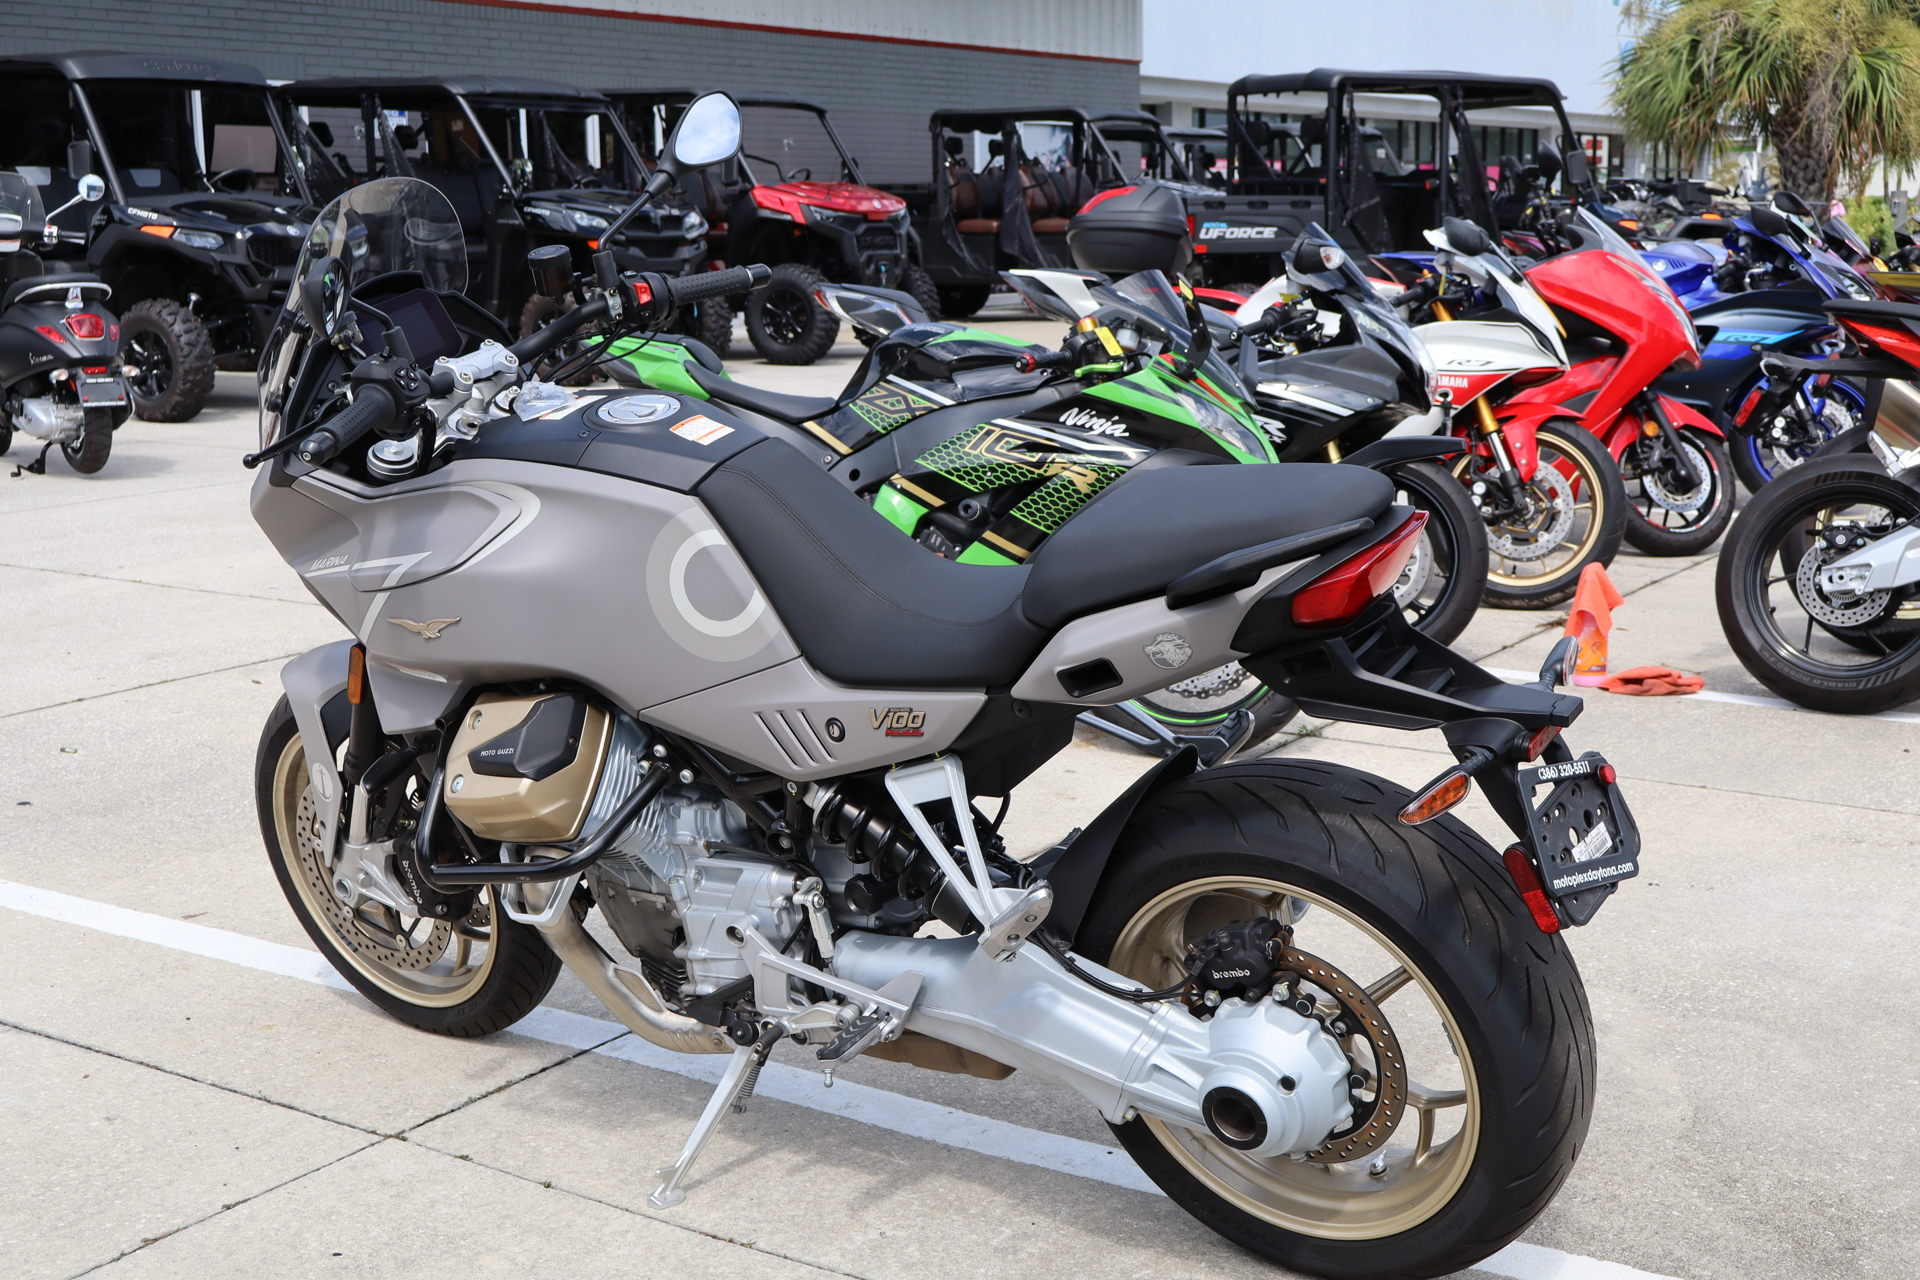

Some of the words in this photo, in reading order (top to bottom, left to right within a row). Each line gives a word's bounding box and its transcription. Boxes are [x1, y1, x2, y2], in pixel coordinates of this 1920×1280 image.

[128, 206, 158, 220] CFMOTO
[1199, 227, 1278, 239] UFORCE
[1445, 358, 1496, 367] R7
[1059, 407, 1129, 437] Ninja
[309, 554, 349, 571] MARINA
[1776, 661, 1811, 682] ROSSO
[1812, 678, 1858, 689] DIABLO
[869, 707, 926, 729] V100
[480, 749, 496, 757] MOTO
[497, 747, 515, 755] GUZZI
[1538, 766, 1558, 780] (386)
[1559, 760, 1591, 777] 320-5511
[402, 860, 423, 904] brembo
[1553, 861, 1635, 890] motoplexdaytona.com
[1211, 967, 1251, 980] brembo
